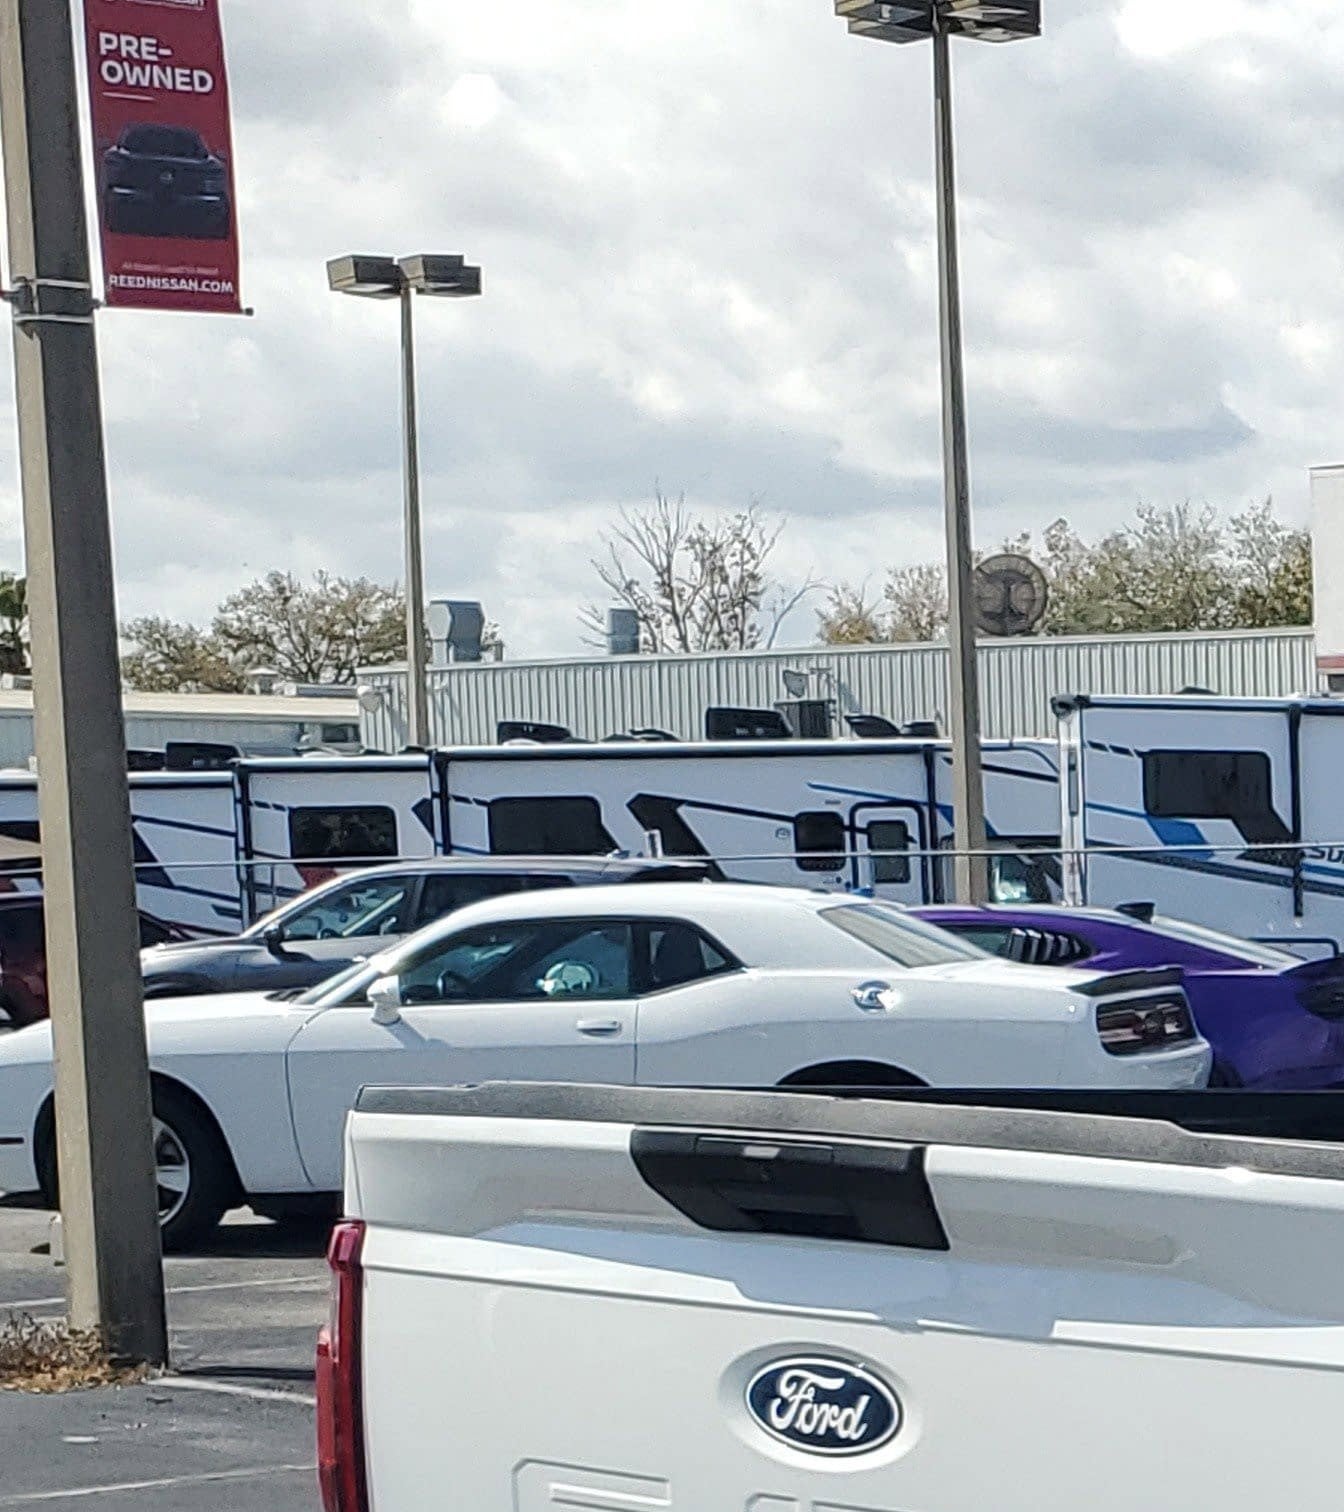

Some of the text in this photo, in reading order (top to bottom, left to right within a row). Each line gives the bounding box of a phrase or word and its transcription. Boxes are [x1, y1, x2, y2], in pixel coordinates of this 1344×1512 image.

[98, 32, 172, 61] PRE-
[100, 60, 214, 93] OWNED
[108, 274, 234, 293] REEDNISSAN.COM
[770, 1369, 870, 1440] Ford
